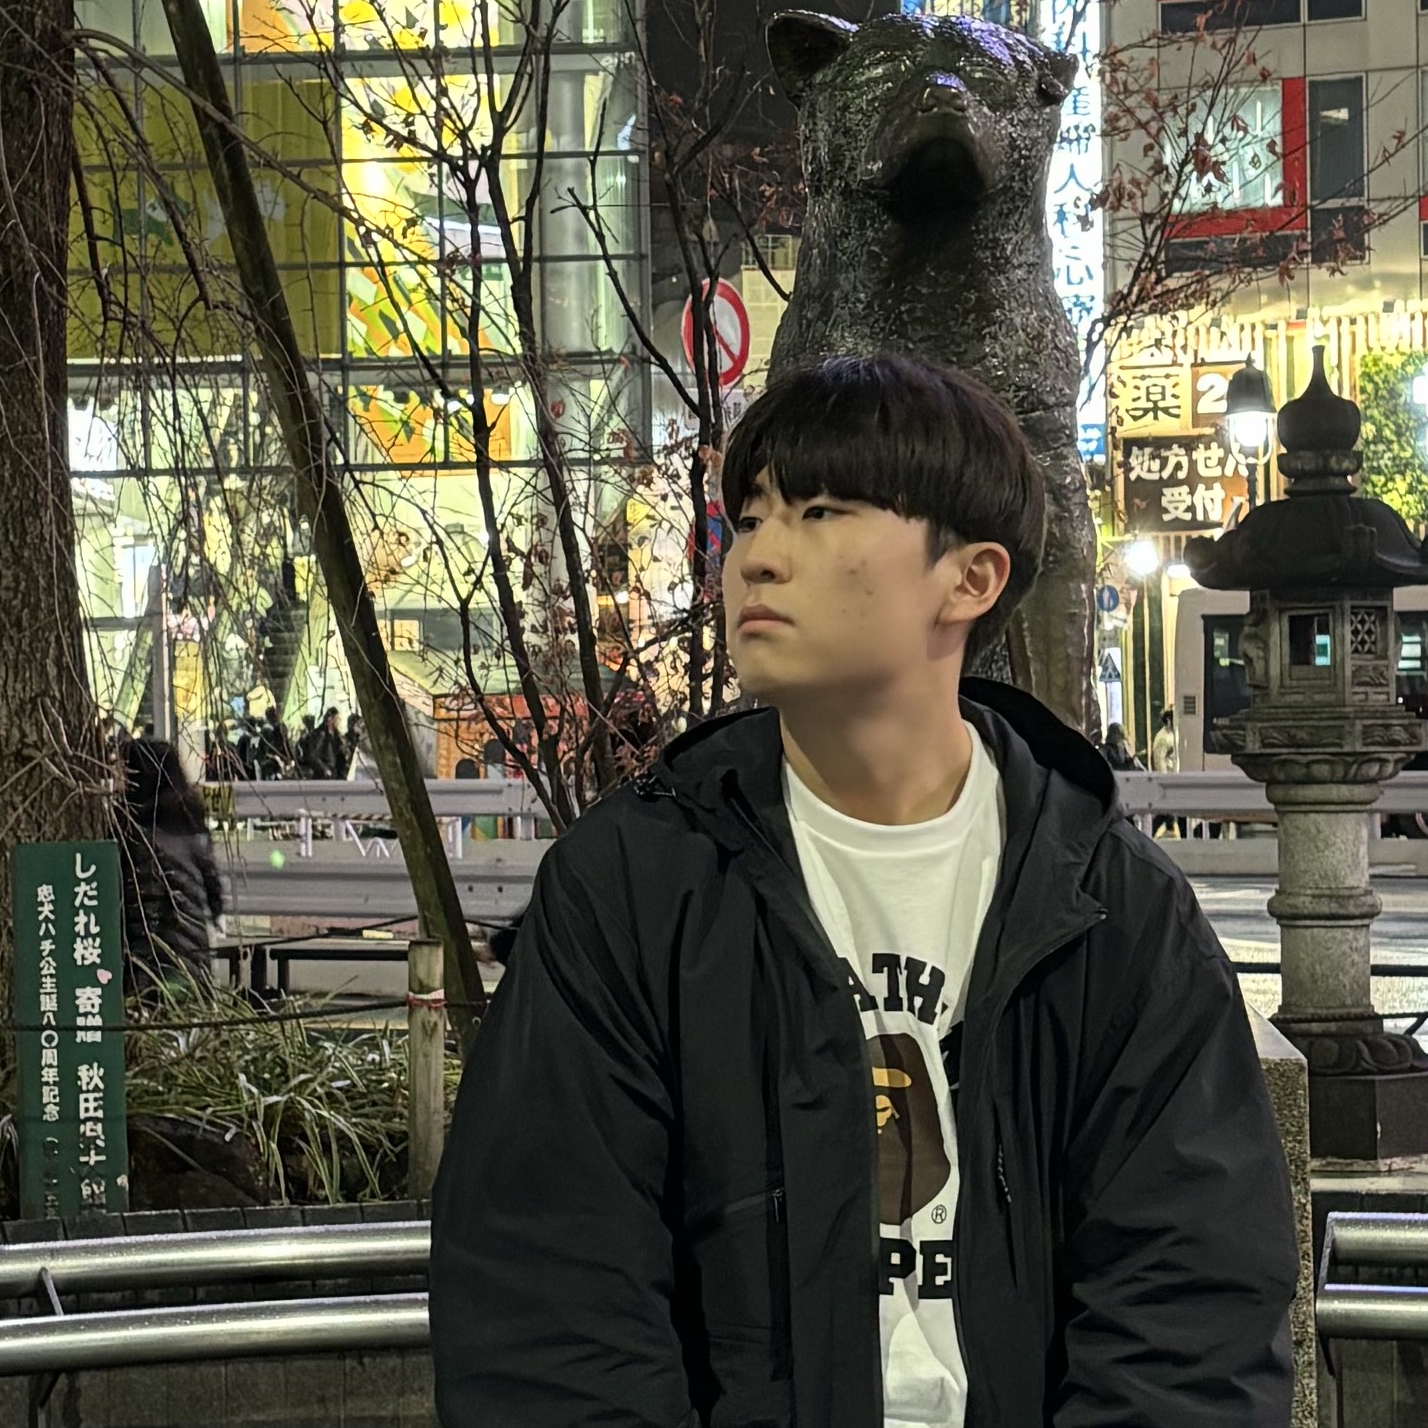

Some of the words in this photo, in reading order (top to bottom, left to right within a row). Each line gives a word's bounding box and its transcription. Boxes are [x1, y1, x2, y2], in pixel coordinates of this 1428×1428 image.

[1126, 374, 1182, 422] 薬
[1161, 484, 1226, 523] 受付
[74, 852, 103, 967] しだれ桜
